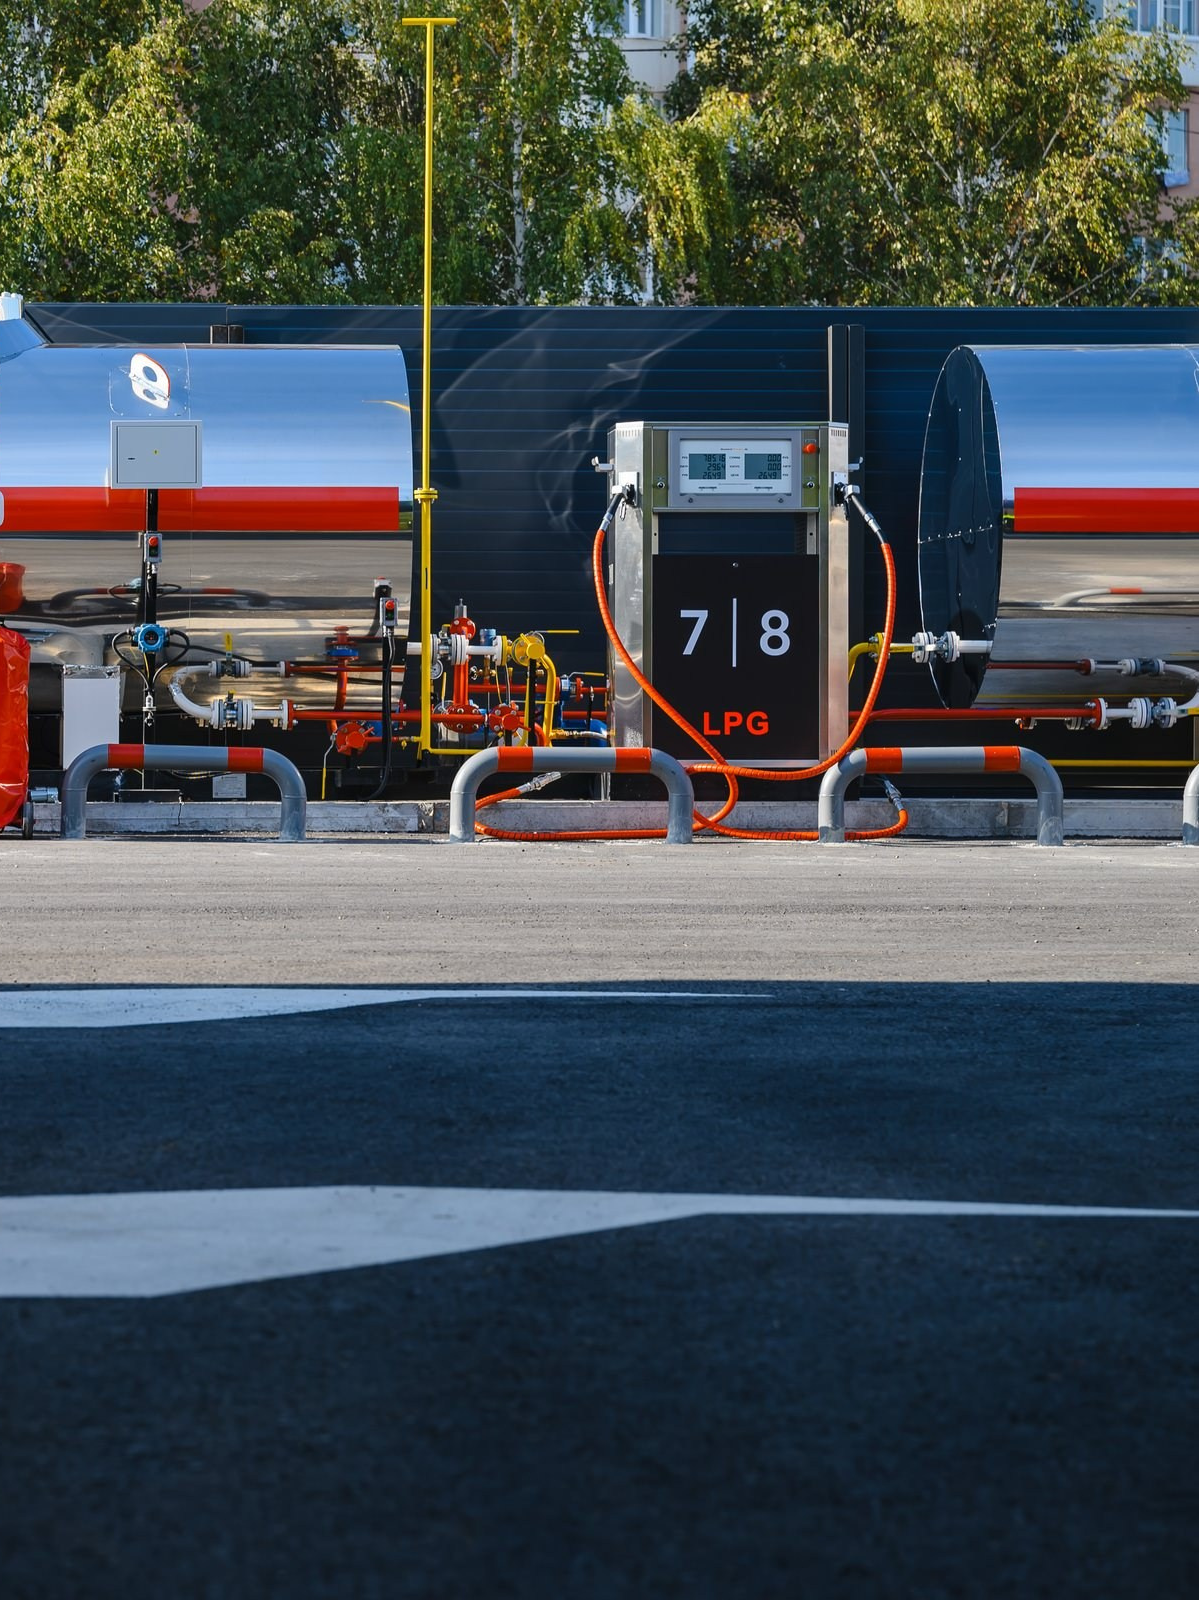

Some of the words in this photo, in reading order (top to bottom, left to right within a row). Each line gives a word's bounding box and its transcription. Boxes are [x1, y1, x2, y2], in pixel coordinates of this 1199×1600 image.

[680, 609, 709, 656] 7
[759, 609, 791, 656] 8
[703, 711, 770, 736] LPG
